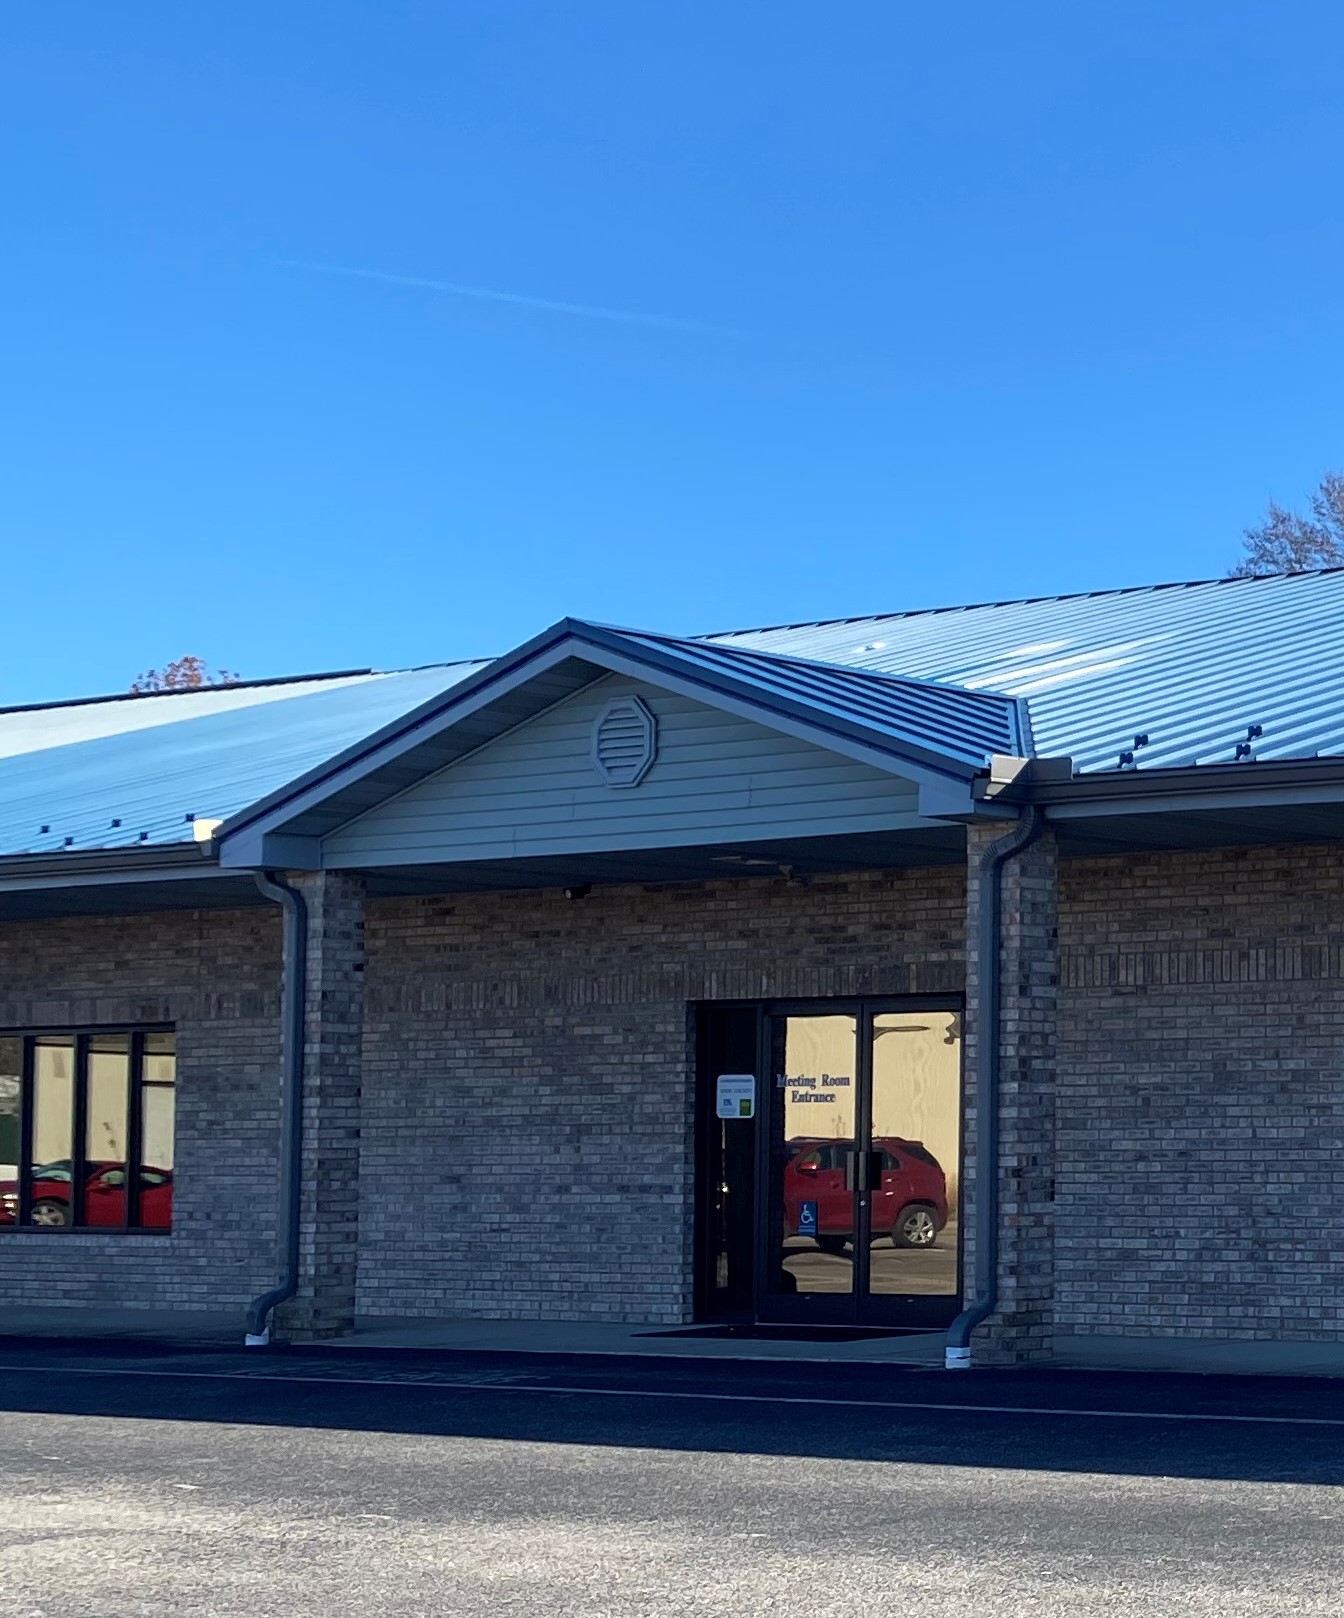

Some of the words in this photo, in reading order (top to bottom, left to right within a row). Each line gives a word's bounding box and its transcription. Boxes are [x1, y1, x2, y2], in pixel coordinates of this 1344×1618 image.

[776, 1073, 817, 1090] Meeting
[821, 1073, 851, 1087] Room
[791, 1090, 836, 1103] Entrance
